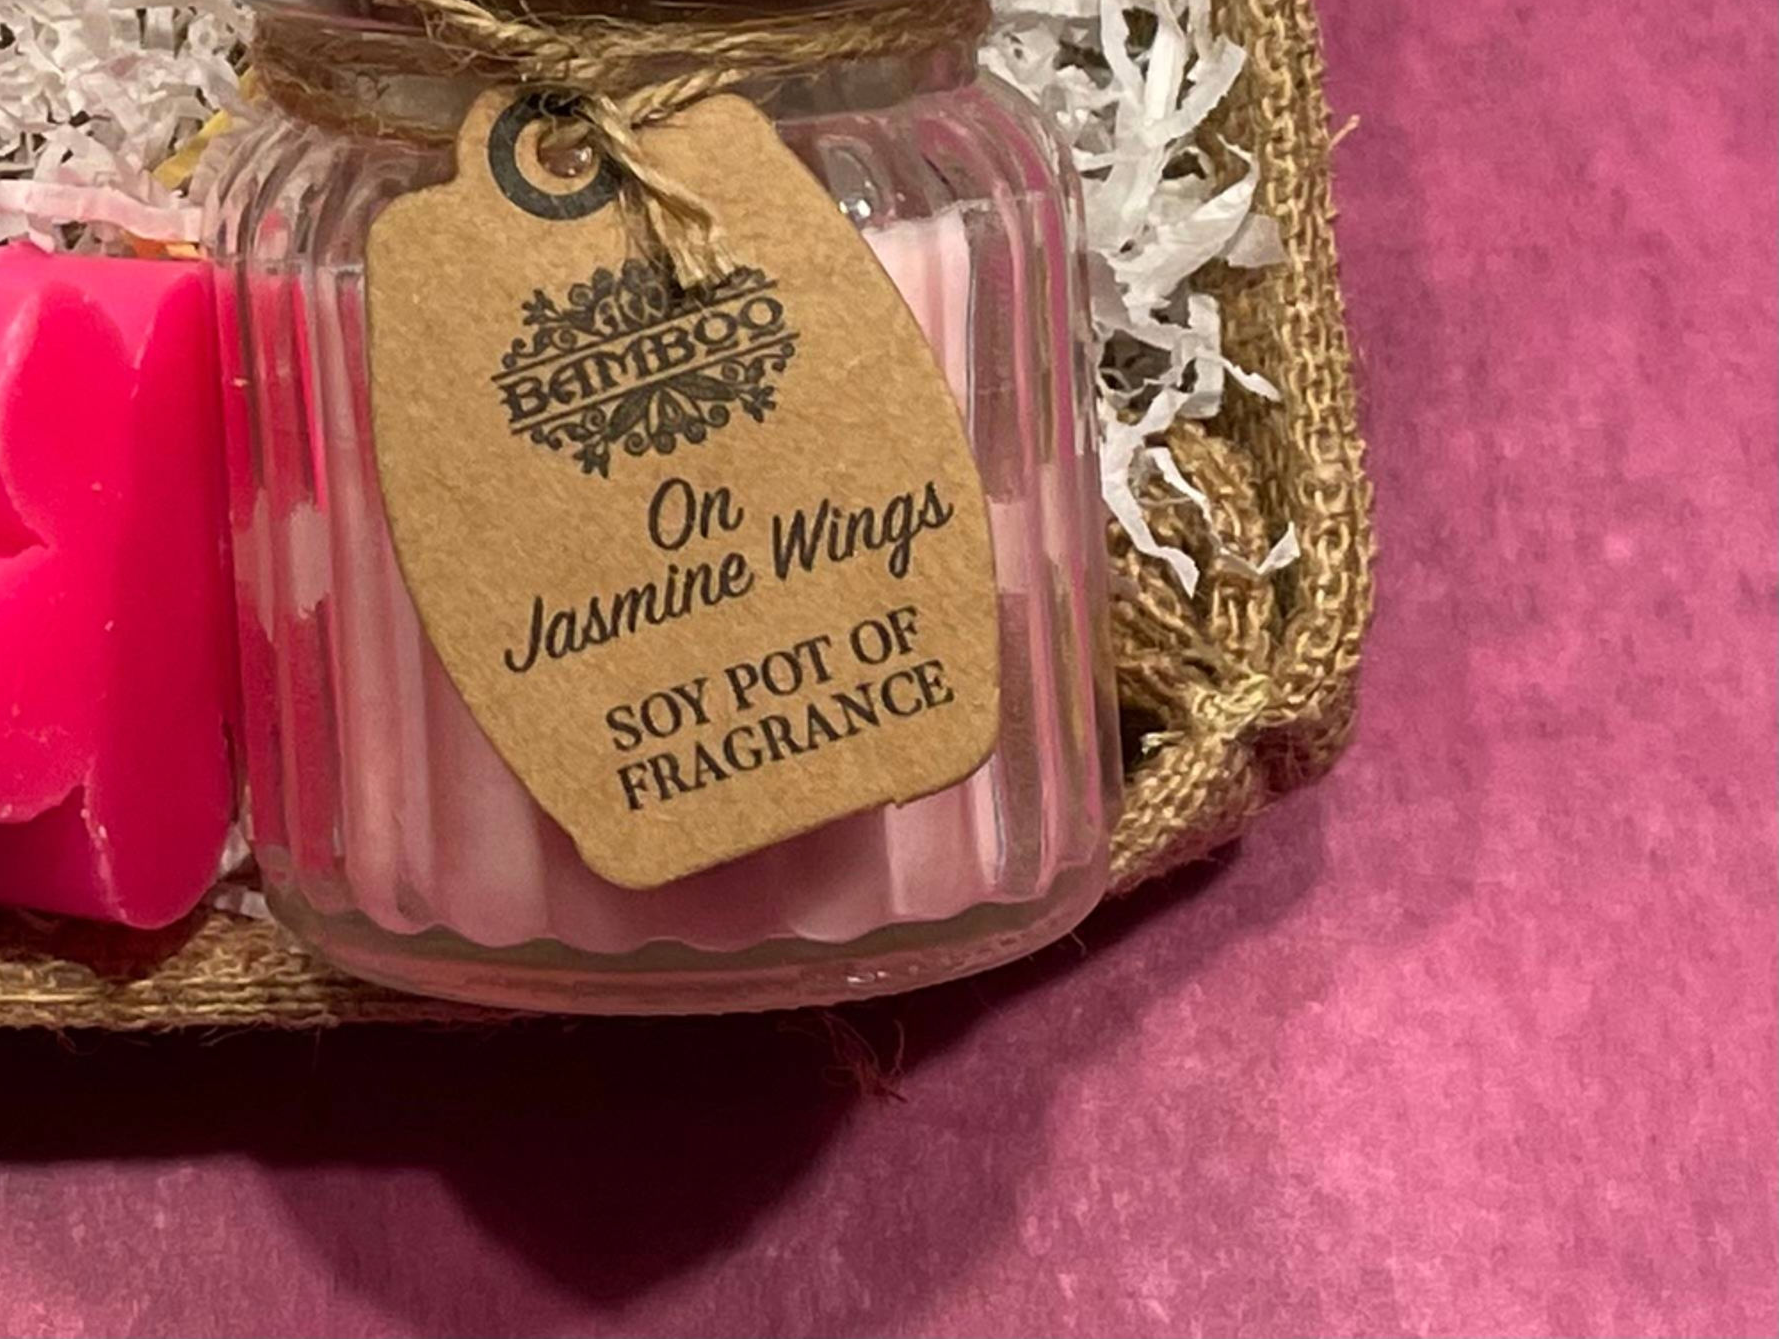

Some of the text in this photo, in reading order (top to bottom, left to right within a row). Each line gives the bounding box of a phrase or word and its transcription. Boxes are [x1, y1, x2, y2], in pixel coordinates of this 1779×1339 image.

[499, 296, 787, 422] BAMBOO
[503, 479, 955, 674] Jasmine Wings
[647, 476, 744, 553] On
[604, 605, 922, 752] SOY POT OF
[616, 658, 956, 813] FRAGRANCE
